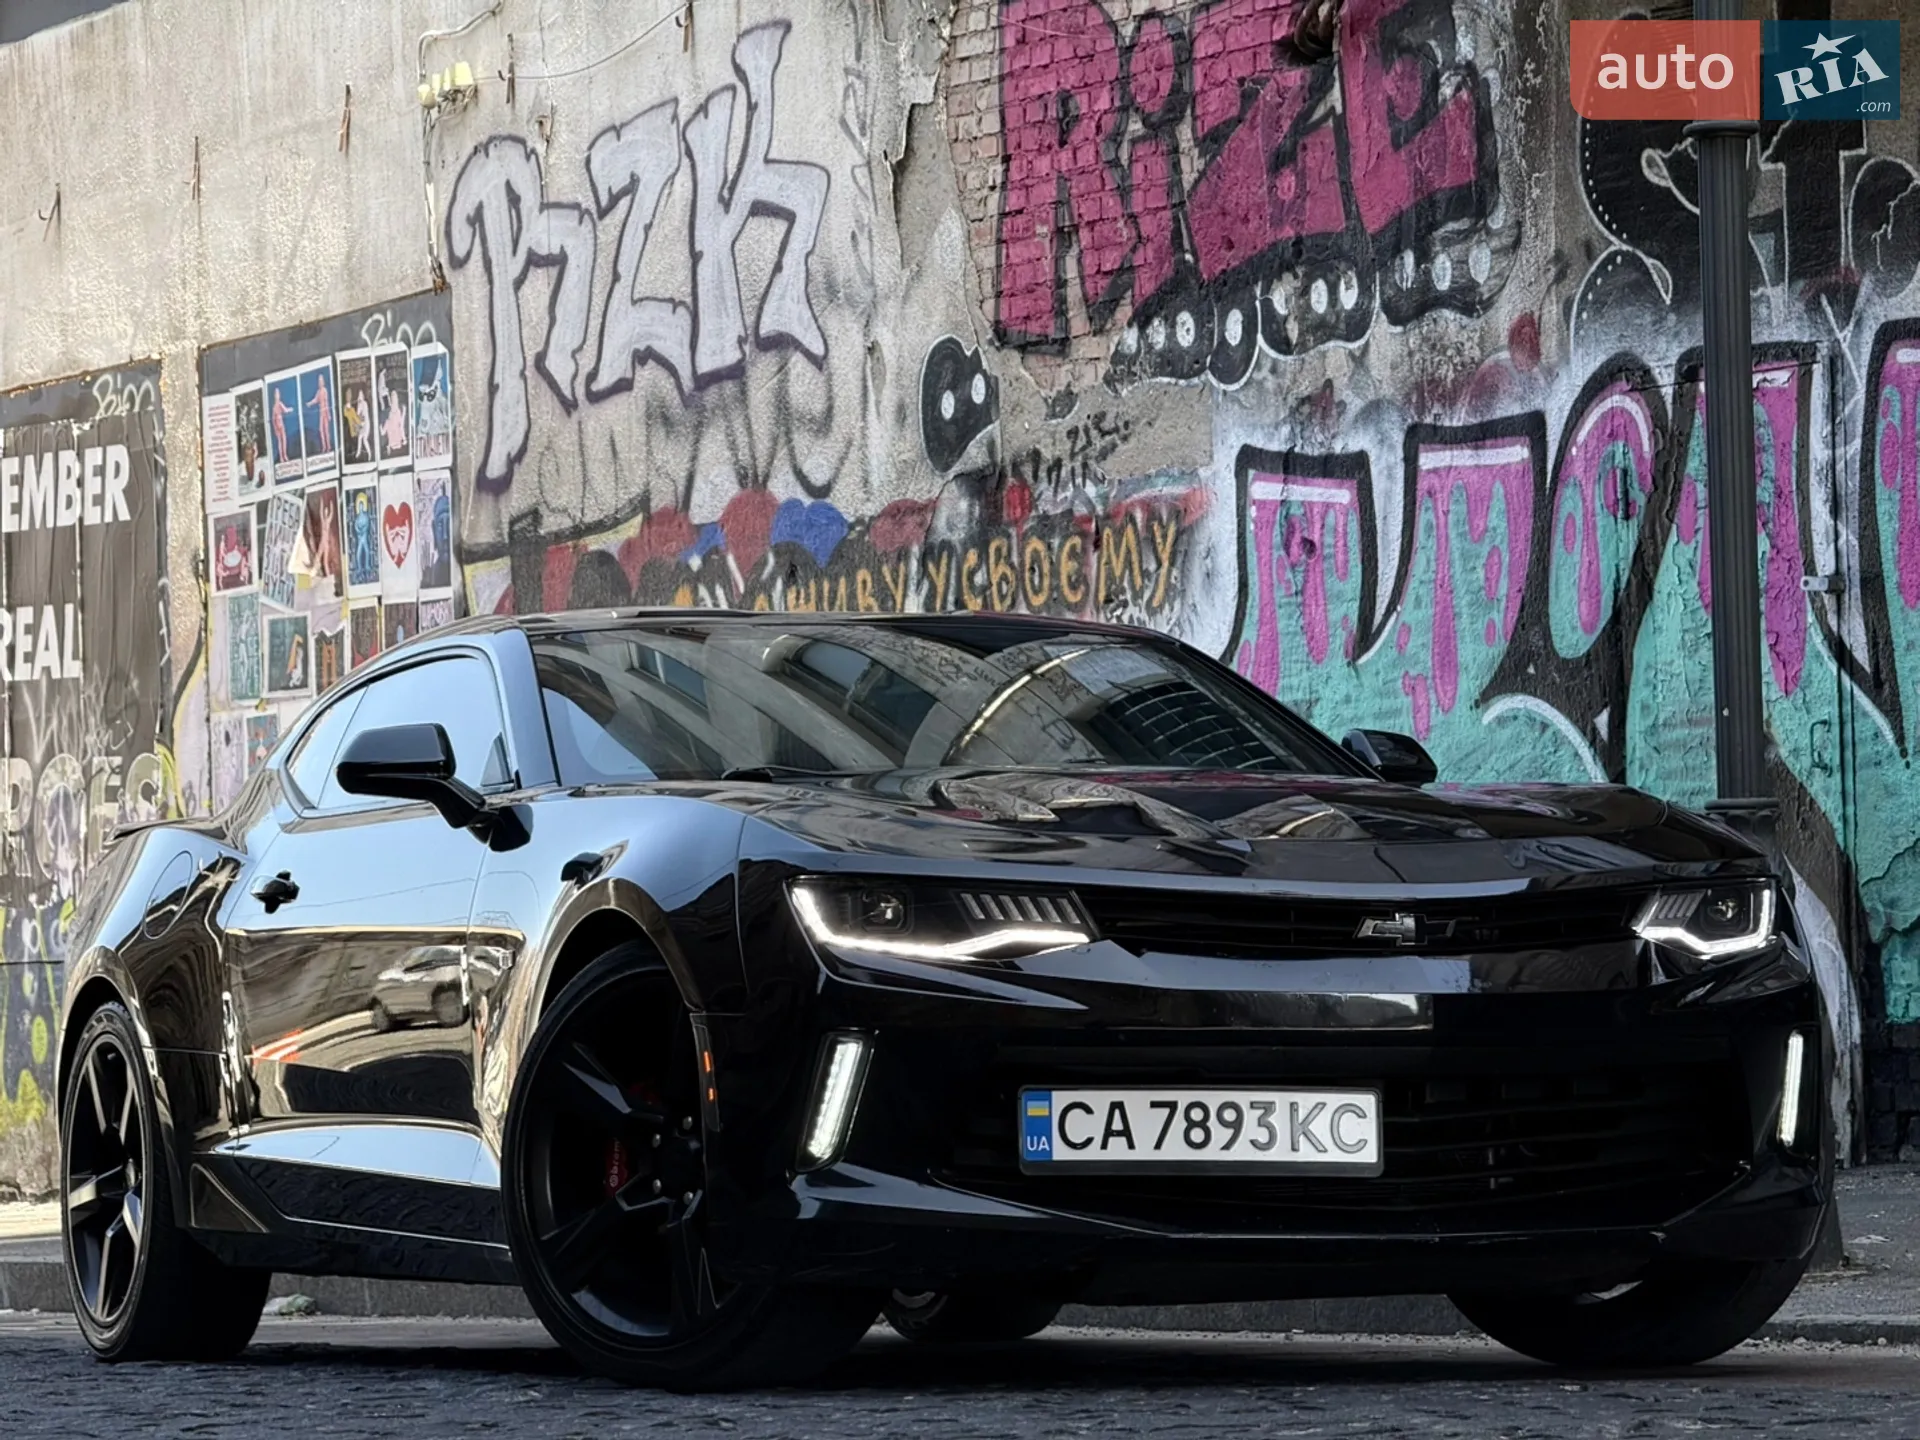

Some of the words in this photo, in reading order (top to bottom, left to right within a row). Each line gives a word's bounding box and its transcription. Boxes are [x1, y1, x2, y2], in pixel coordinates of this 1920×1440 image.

[1026, 1136, 1050, 1152] UA
[1057, 1100, 1136, 1151] CA
[1149, 1100, 1279, 1152] 7893
[1290, 1101, 1369, 1154] KC
